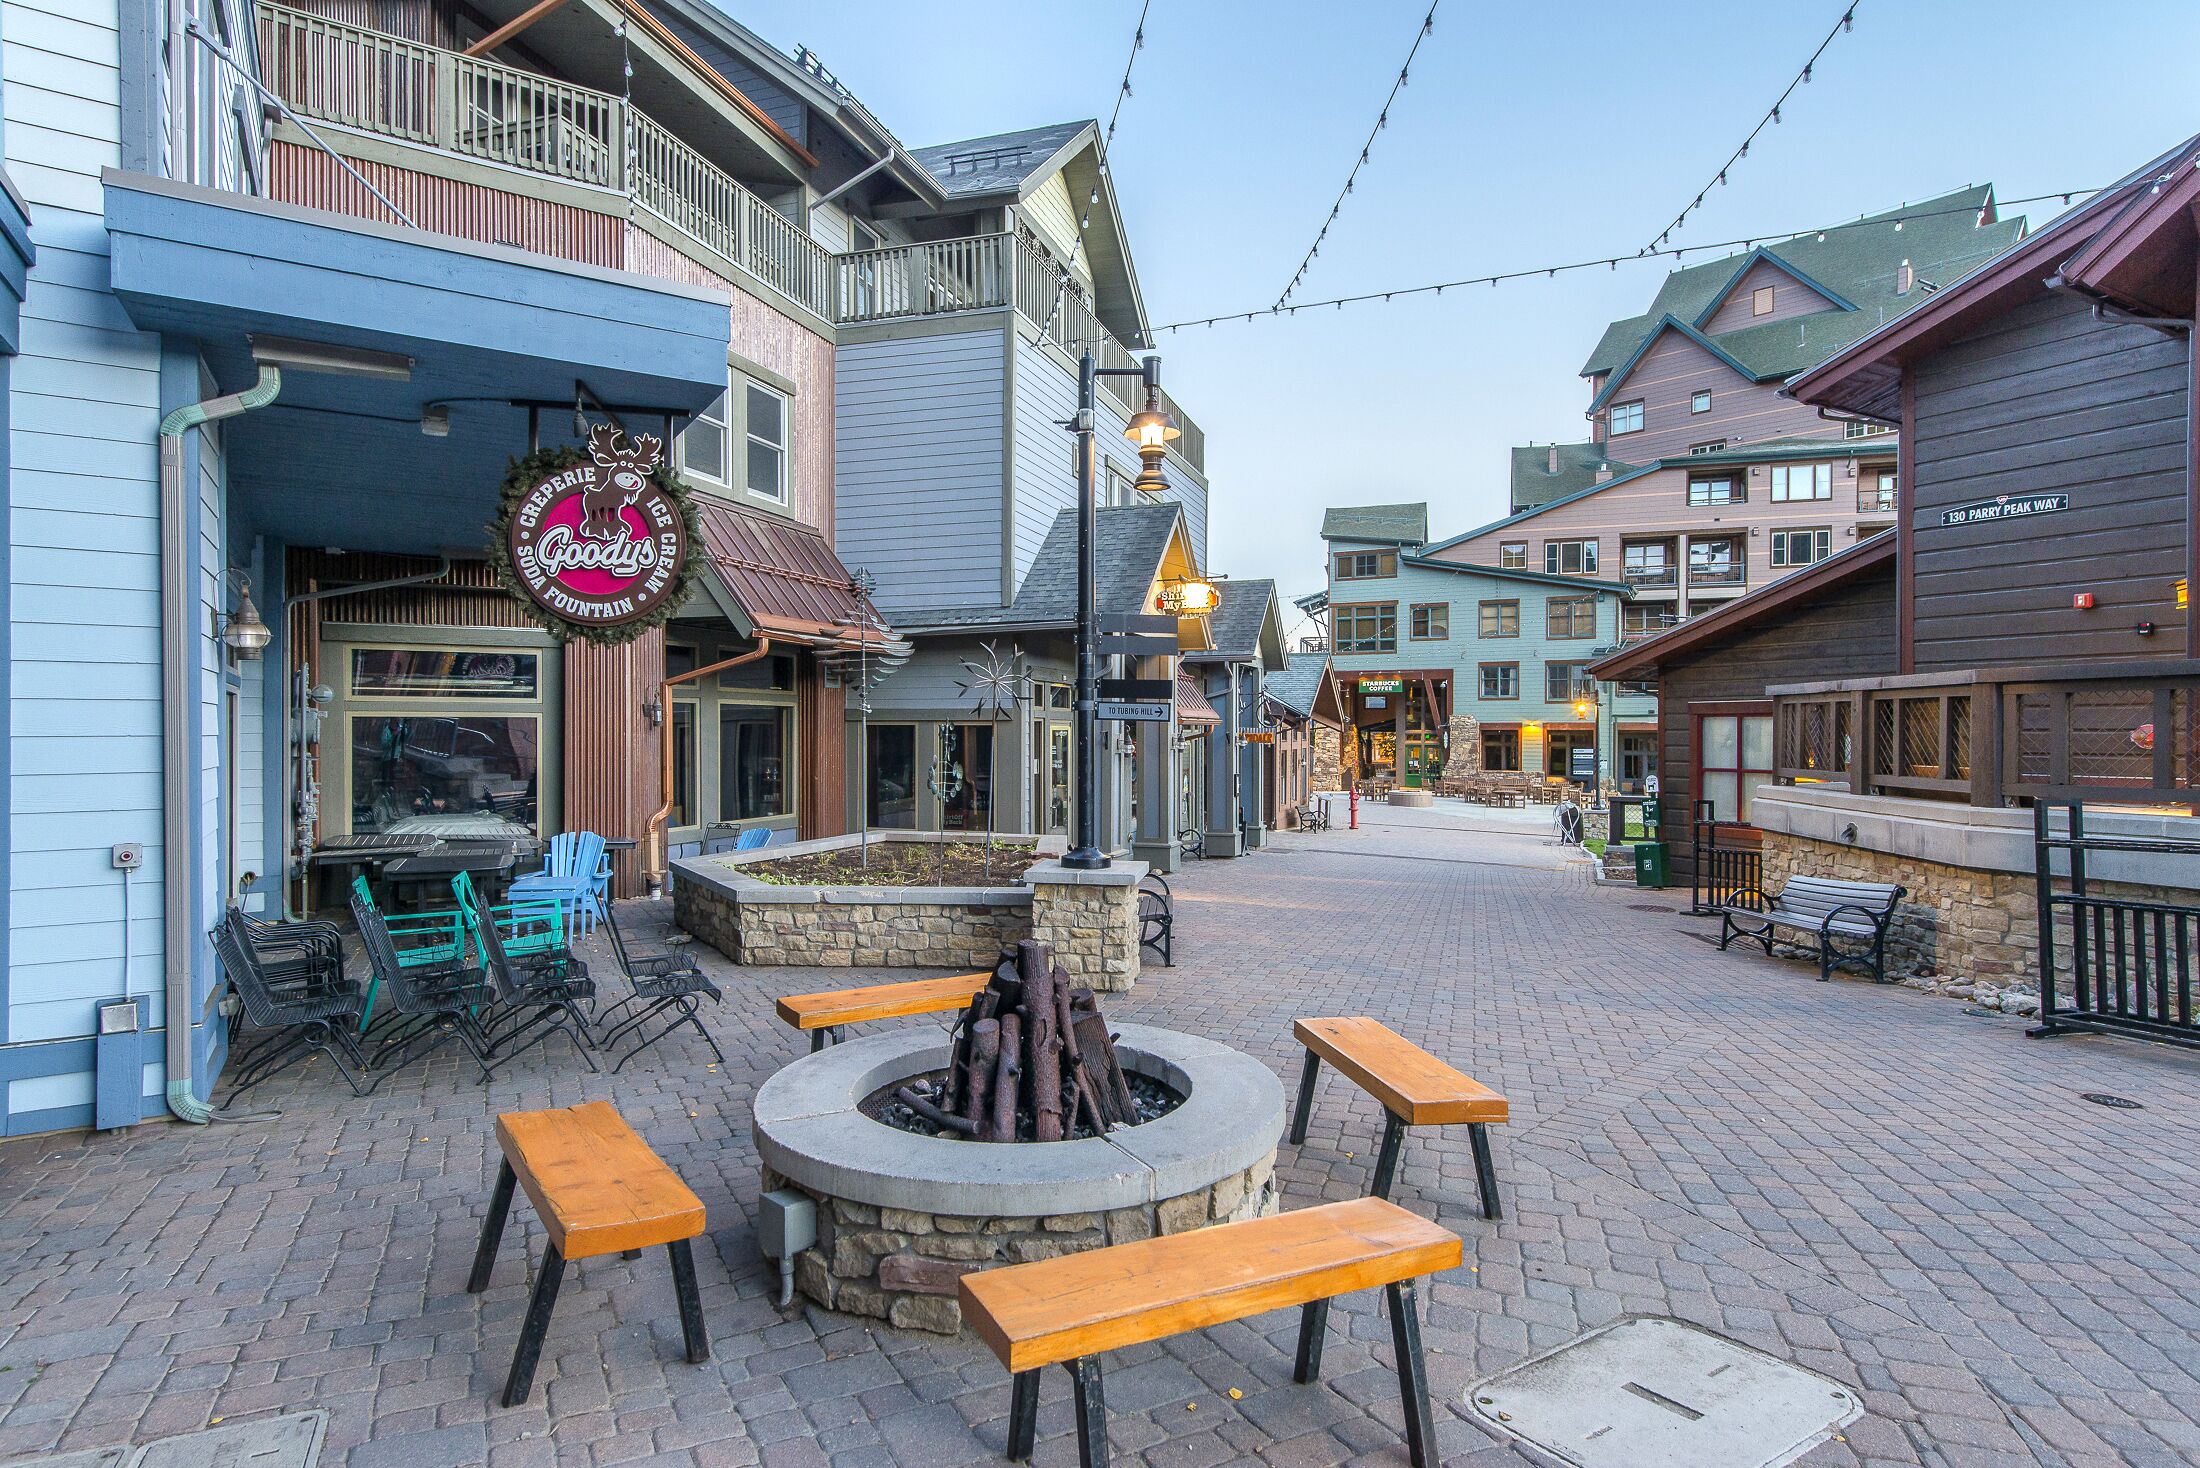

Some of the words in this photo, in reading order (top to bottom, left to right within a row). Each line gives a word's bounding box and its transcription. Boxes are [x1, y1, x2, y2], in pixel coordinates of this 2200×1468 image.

[520, 467, 596, 528] CREPERIE
[646, 496, 673, 528] ICE
[1948, 510, 1966, 523] 130
[1969, 506, 2002, 519] PARRY
[2004, 502, 2031, 515] PEAK
[2034, 497, 2060, 511] WAY
[517, 545, 547, 591] SODA
[543, 586, 634, 618] FOUNTAIN
[644, 532, 677, 594] CREAM
[1109, 707, 1116, 715] TO
[1117, 707, 1139, 715] TUBING
[1140, 708, 1154, 716] HILL
